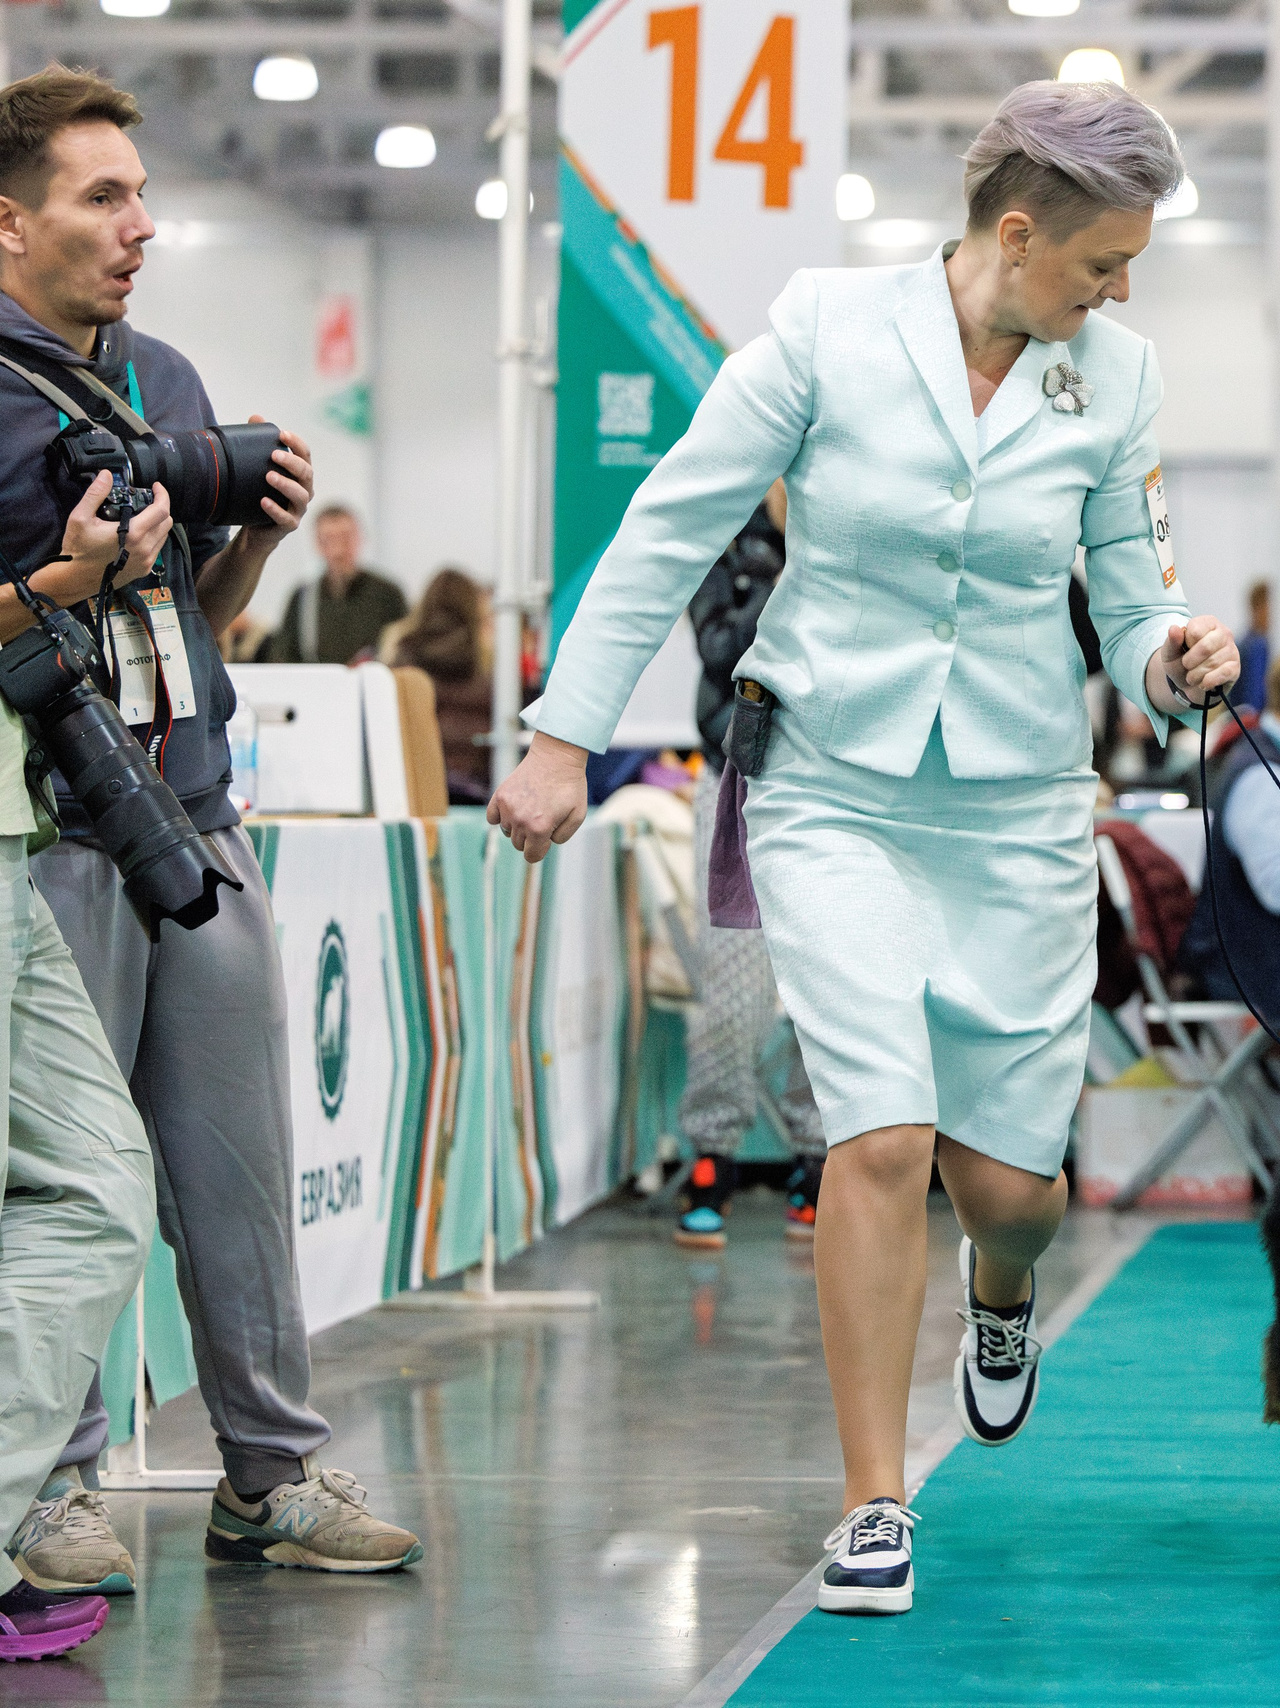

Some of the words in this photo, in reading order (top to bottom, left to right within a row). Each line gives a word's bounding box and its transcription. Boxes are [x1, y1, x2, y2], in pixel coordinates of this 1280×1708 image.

[648, 5, 804, 209] 14
[126, 653, 171, 666] ФОТОГАФ
[133, 707, 138, 717] 1
[179, 701, 186, 710] 3
[148, 735, 162, 768] non
